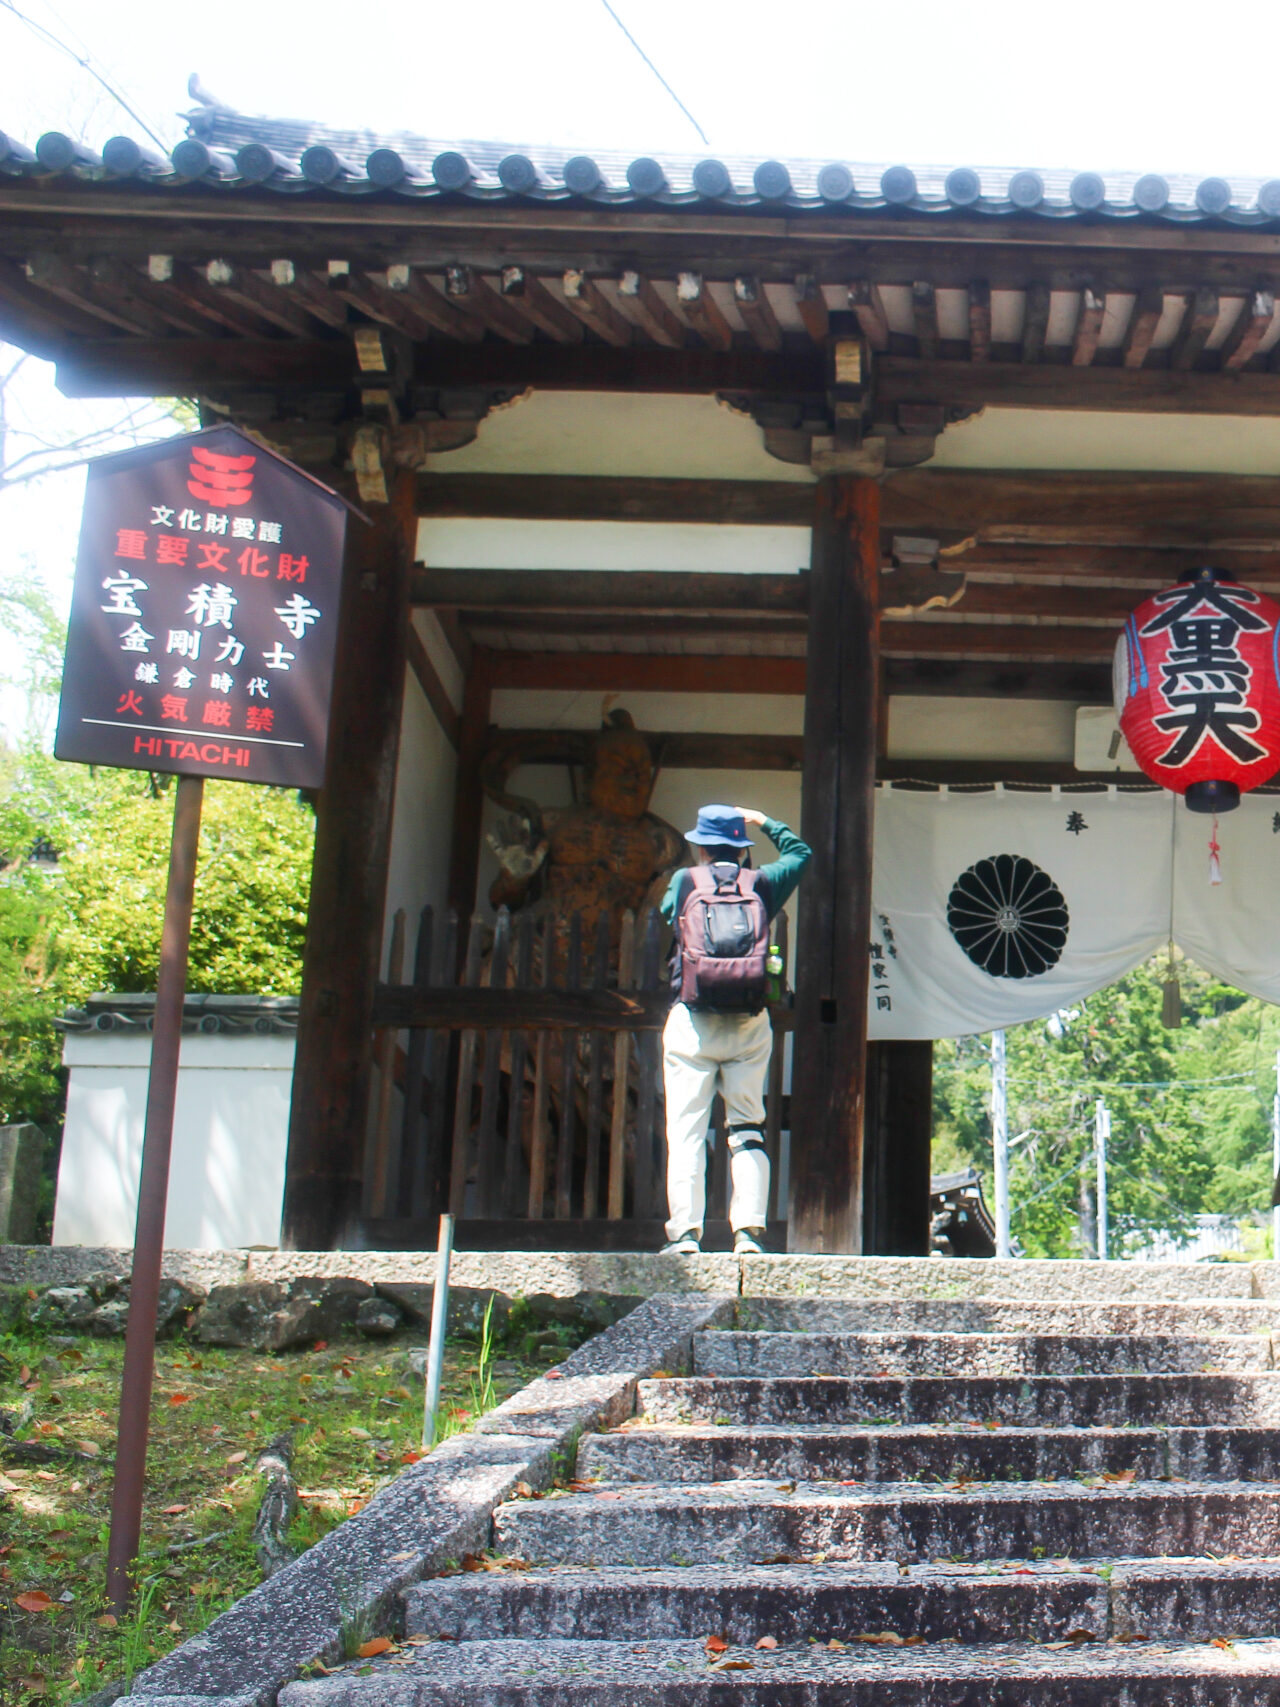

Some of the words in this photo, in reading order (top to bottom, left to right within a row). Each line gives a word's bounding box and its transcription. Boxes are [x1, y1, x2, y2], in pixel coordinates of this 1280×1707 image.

[151, 505, 283, 544] 文化財愛護
[114, 528, 310, 583] 重要文化財
[100, 569, 321, 640] 宝積寺
[119, 621, 296, 671] 金剛力士
[134, 662, 271, 699] 鎌倉時代
[1139, 580, 1272, 768] 大黒天
[115, 689, 276, 733] 火気厳禁
[133, 736, 251, 768] HITACHI
